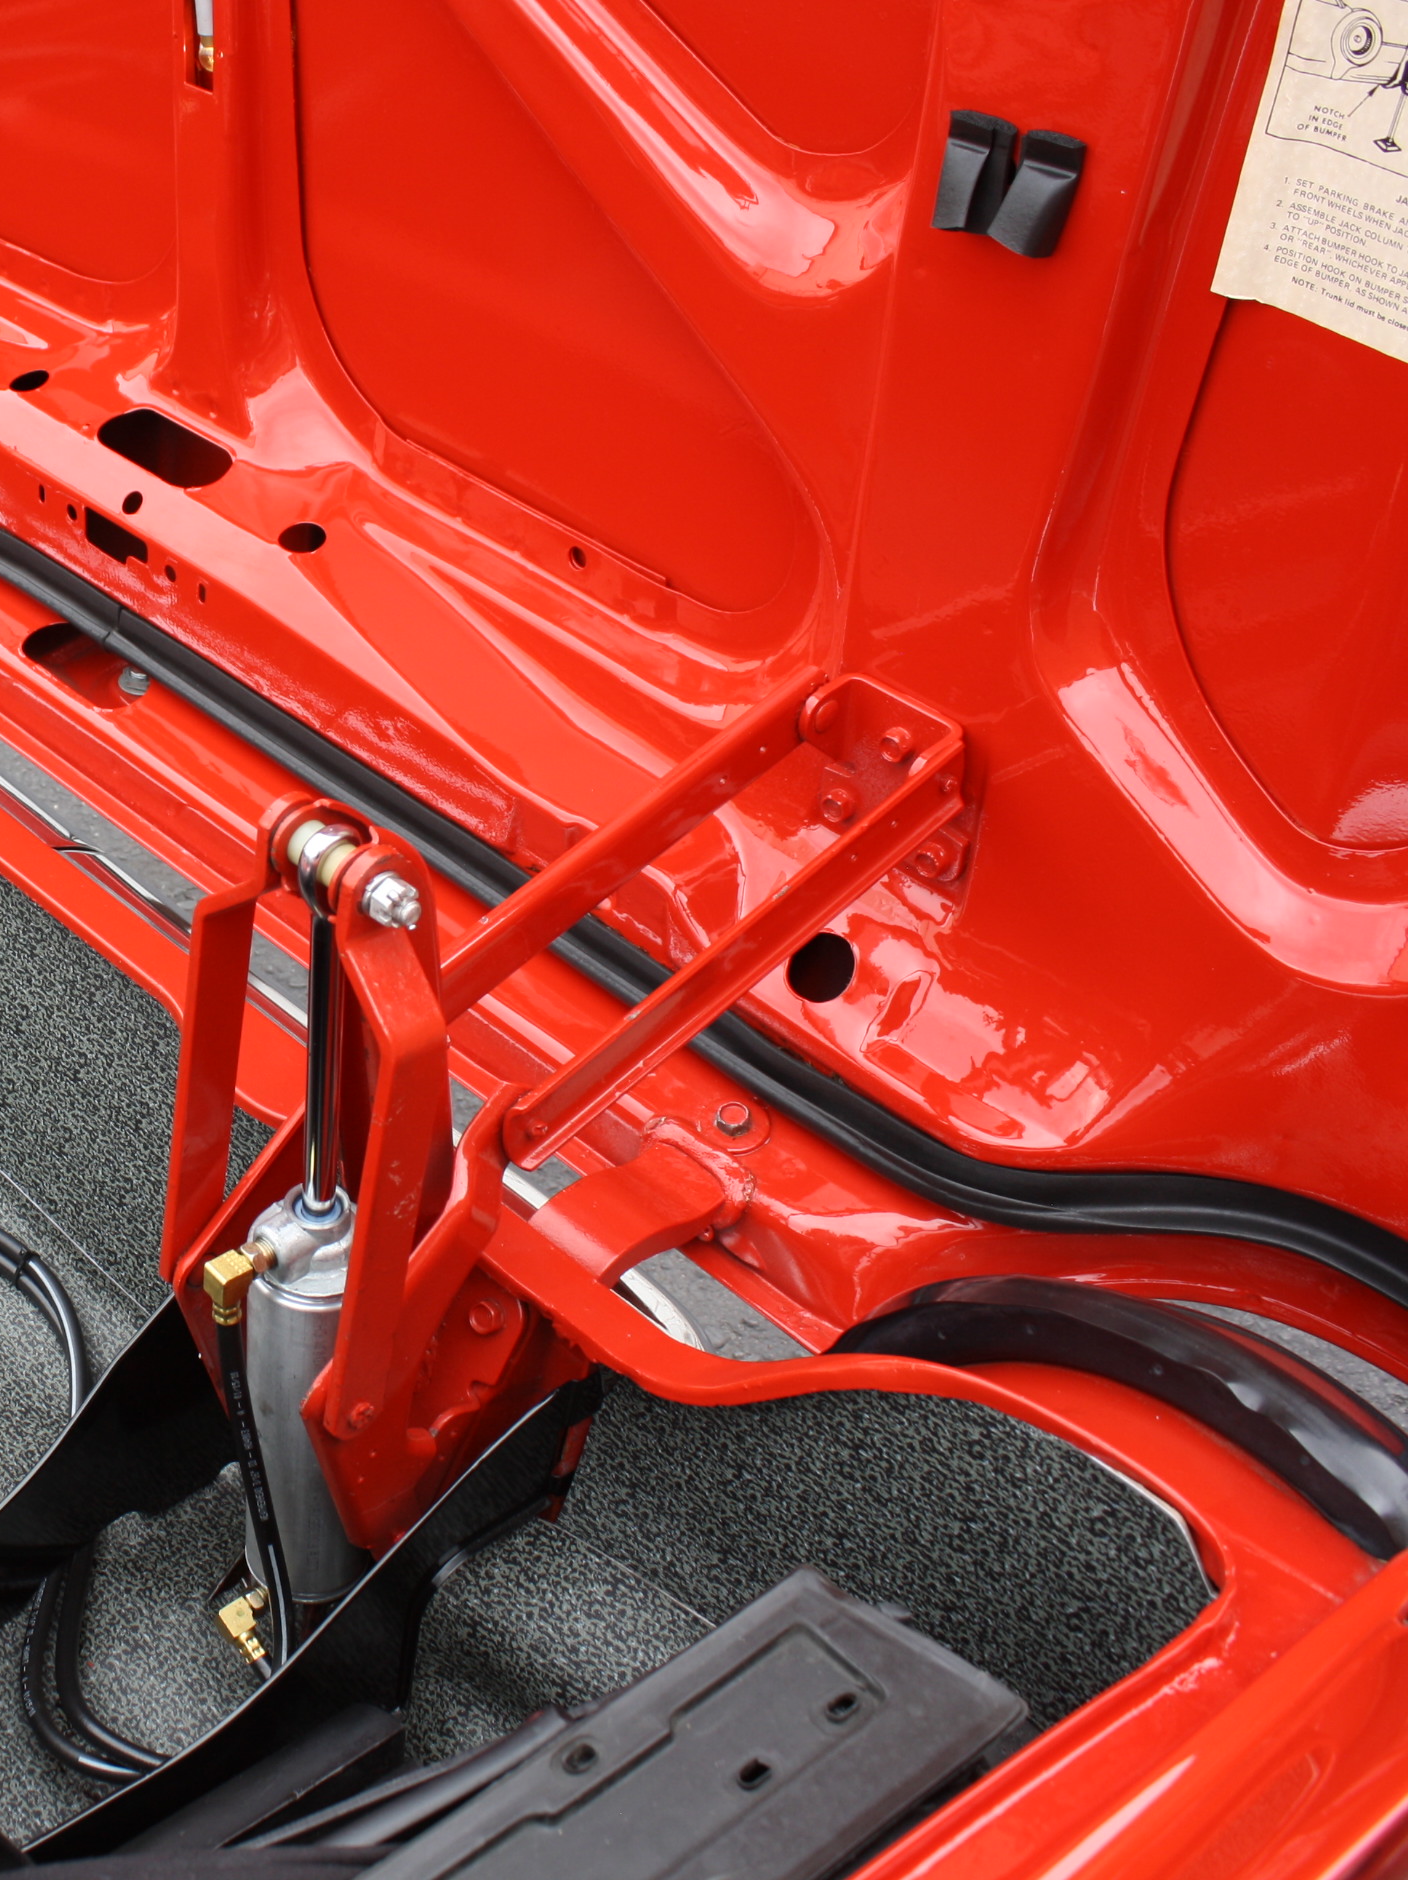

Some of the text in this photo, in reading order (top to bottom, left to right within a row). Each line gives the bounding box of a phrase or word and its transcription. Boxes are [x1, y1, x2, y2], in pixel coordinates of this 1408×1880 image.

[1313, 125, 1347, 141] BUMPER
[1314, 105, 1345, 119] NOTCH
[1322, 117, 1343, 131] EDGE
[1287, 211, 1300, 220] TO
[1303, 216, 1324, 226] "UP"
[1293, 188, 1326, 204] FRONT
[1327, 200, 1363, 220] WHEELS
[1365, 215, 1391, 230] WHEN
[1296, 178, 1314, 188] SET
[1318, 185, 1359, 207] PARKING
[1363, 202, 1395, 220] BRAKE
[1289, 202, 1336, 224] ASSEMBLE
[1339, 221, 1361, 234] JACK
[1364, 230, 1403, 250] COLUMN
[1280, 233, 1294, 242] OR
[1335, 252, 1388, 280] WHICHEVER
[1283, 225, 1320, 242] ATTACH
[1321, 237, 1357, 257] BUMPER
[1358, 252, 1385, 269] HOOK
[1387, 263, 1398, 274] TO
[1274, 255, 1299, 269] EDGE
[1301, 264, 1313, 273] OF
[1355, 287, 1366, 297] AS
[1367, 292, 1400, 311] SHOWN
[1276, 246, 1318, 267] POSITION
[1321, 262, 1346, 278] HOOK
[1348, 273, 1362, 284] ON
[1364, 280, 1401, 301] BUMPER
[1291, 276, 1319, 293] NOTE:
[1321, 287, 1342, 304] Trunk
[1344, 298, 1355, 308] lid
[1356, 304, 1375, 317] must
[1376, 312, 1386, 322] be
